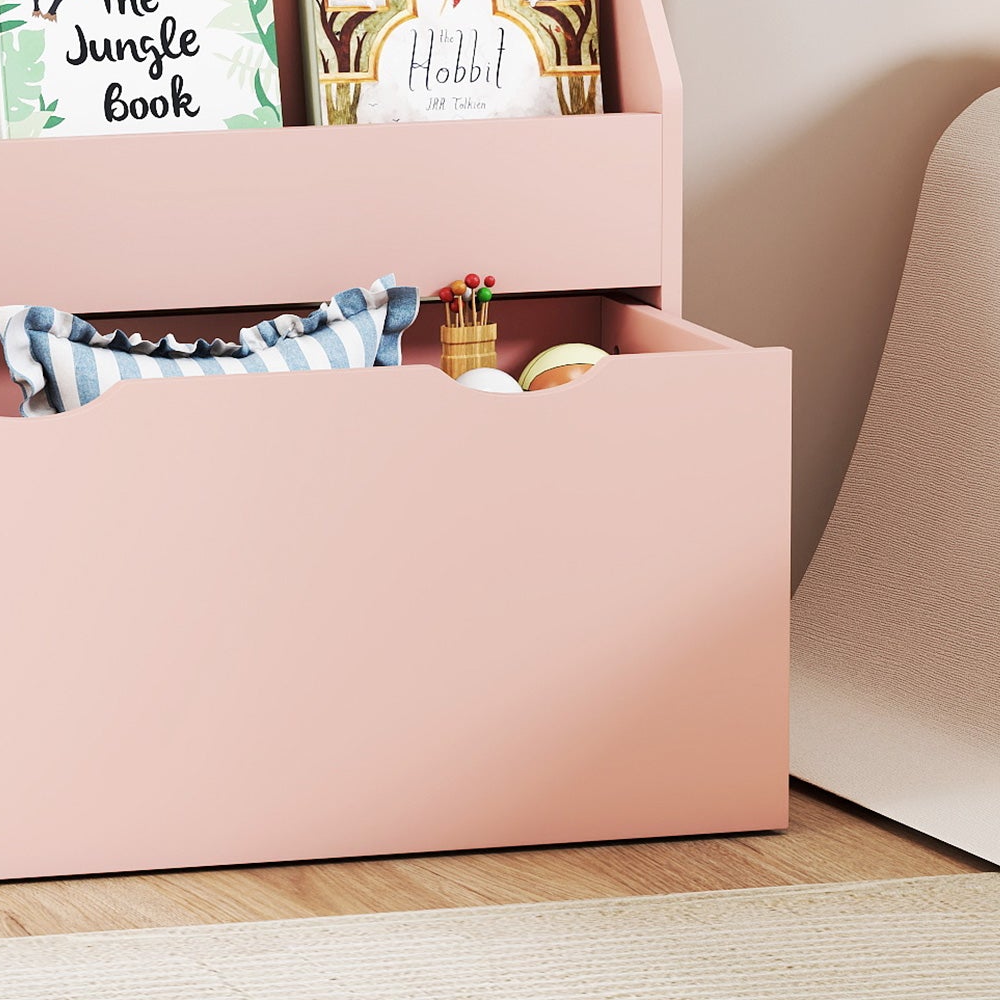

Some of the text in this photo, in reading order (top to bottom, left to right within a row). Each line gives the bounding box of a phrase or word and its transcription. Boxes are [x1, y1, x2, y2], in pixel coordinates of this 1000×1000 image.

[66, 16, 200, 80] Jungle
[409, 27, 506, 92] Hobbit
[440, 29, 454, 43] the
[104, 74, 201, 123] Book
[452, 97, 487, 110] Tolkien
